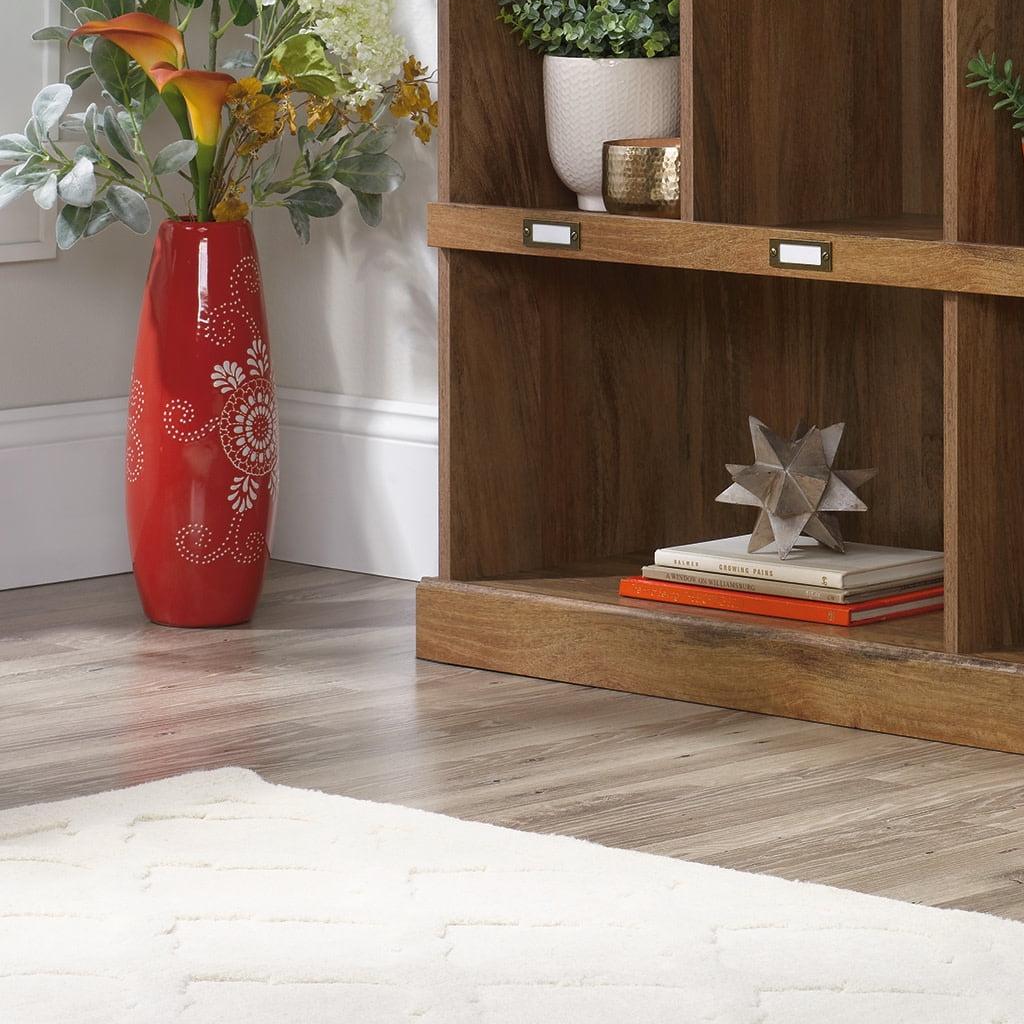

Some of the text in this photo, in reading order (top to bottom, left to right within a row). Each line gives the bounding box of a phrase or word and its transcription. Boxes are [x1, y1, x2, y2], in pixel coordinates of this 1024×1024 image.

[718, 564, 749, 574] GROWING
[752, 568, 774, 576] PAINS
[670, 573, 696, 583] WINDOW
[707, 578, 756, 591] WILLIAMSBURG
